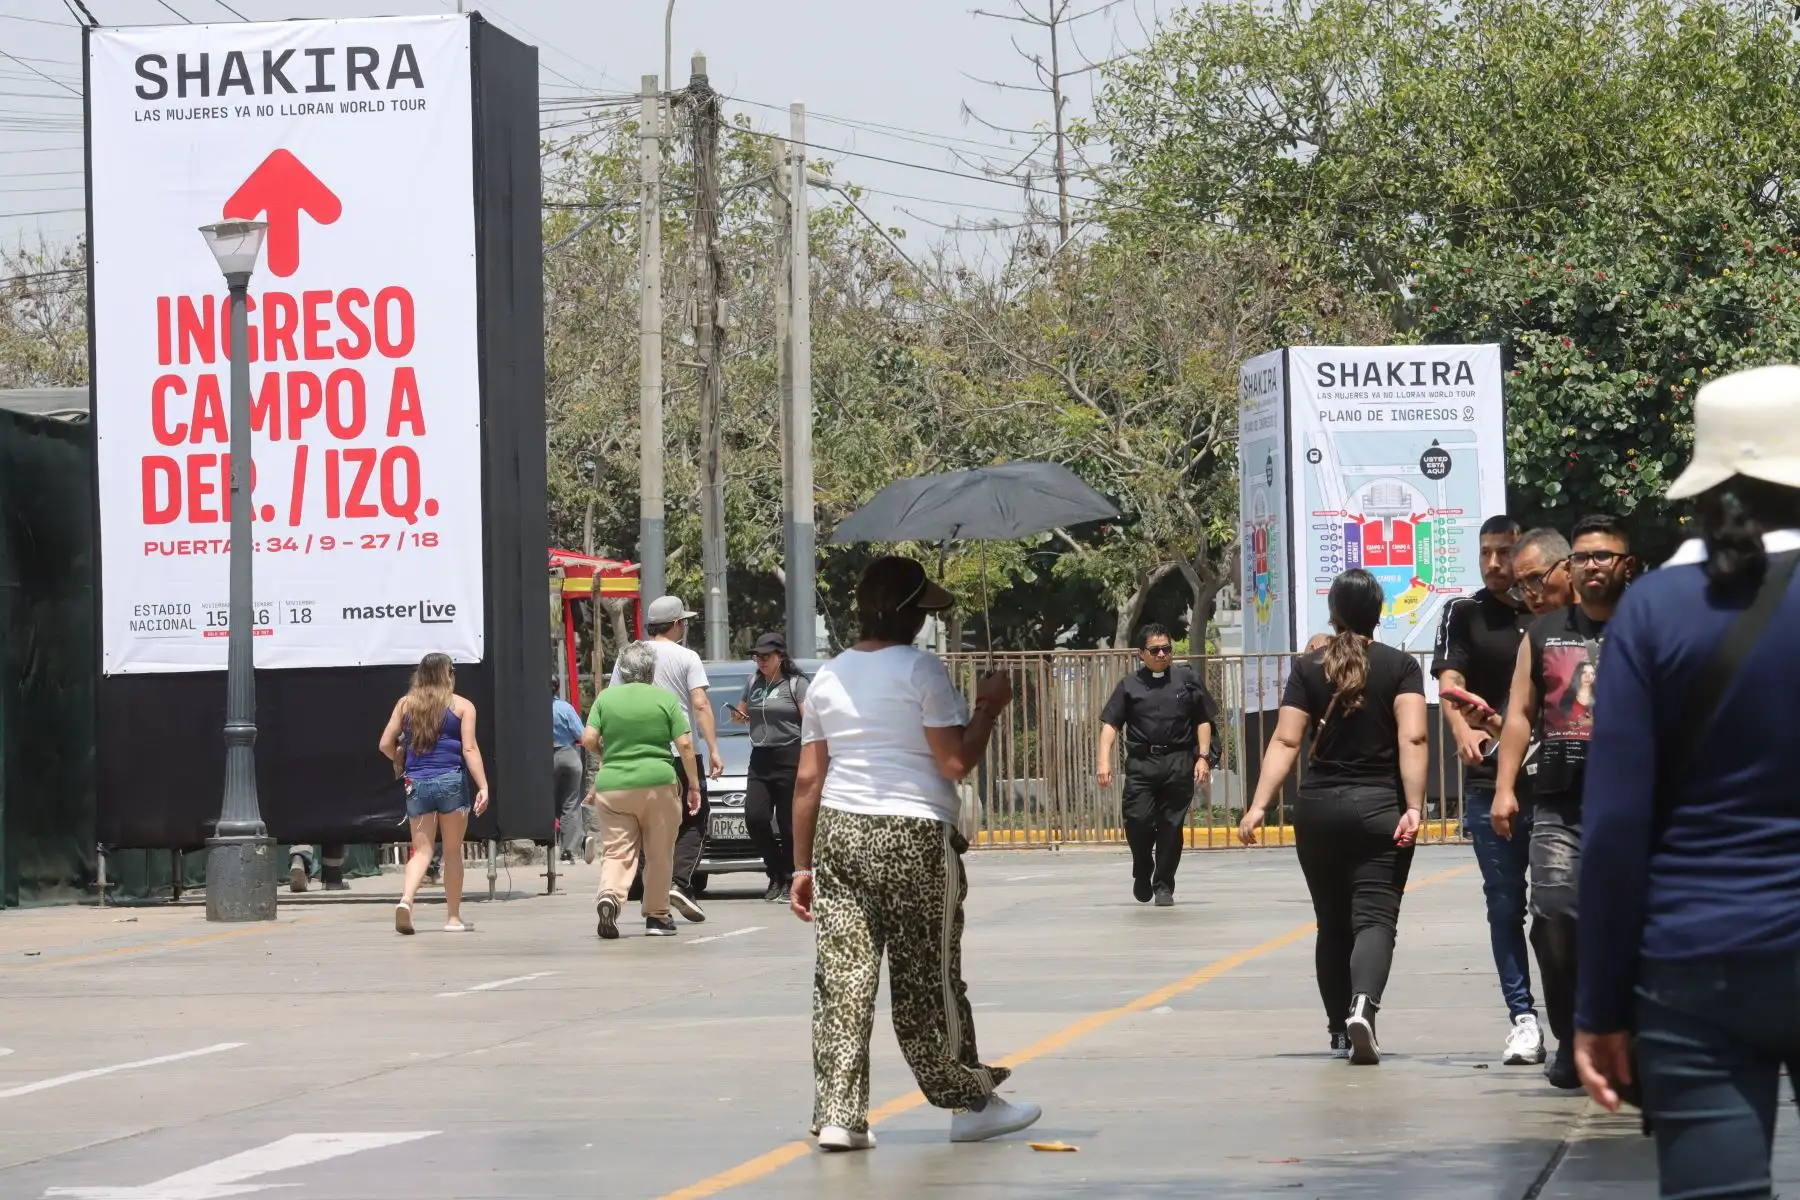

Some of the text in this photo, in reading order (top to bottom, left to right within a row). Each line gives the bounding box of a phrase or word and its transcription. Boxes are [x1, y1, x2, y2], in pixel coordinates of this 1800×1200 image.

[134, 44, 425, 100] SHAKIRA
[134, 99, 426, 122] LAS MUJERES YA NO LLORAN WORLD TOUR
[157, 286, 415, 365] INGRESO
[1243, 367, 1278, 400] SHAKIRA
[1317, 360, 1475, 388] SHAKIRA
[1371, 391, 1381, 399] YA
[1396, 391, 1426, 399] LLORAN
[1428, 390, 1454, 398] WORLD
[1456, 390, 1476, 398] TOUR
[152, 367, 426, 447] CAMPO A
[1319, 409, 1458, 422] PLANO DE INGRESOS
[325, 445, 439, 526] IZQ.
[266, 537, 298, 552] 34
[319, 536, 336, 550] 9
[360, 533, 391, 549] 27
[411, 532, 439, 547] 18
[134, 603, 191, 616] ESTADIO
[206, 610, 228, 627] 15
[289, 607, 312, 624] 18
[130, 618, 196, 631] NACIONAL
[713, 821, 748, 835] APK-6
